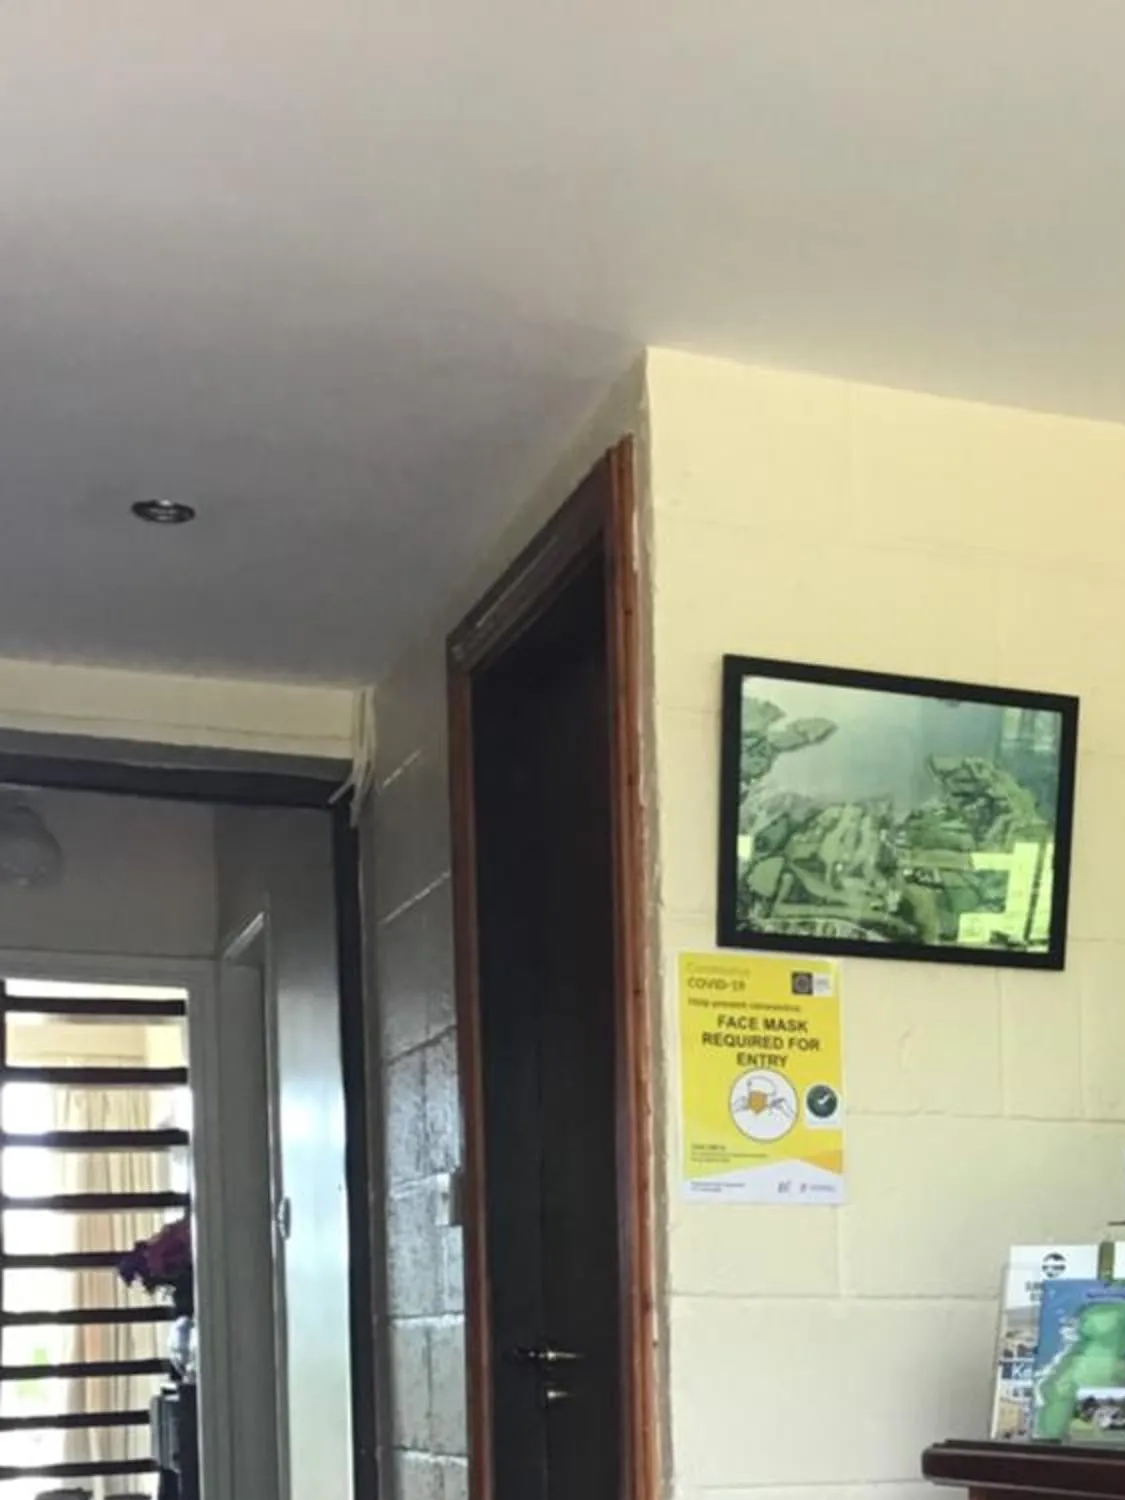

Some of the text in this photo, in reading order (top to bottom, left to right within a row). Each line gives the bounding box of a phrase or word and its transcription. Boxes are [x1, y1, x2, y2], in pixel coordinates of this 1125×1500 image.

[687, 976, 747, 992] COVID-19
[716, 1012, 809, 1034] FACE MASK
[701, 1031, 821, 1052] REQUIRED FOR
[735, 1051, 789, 1069] ENTRY
